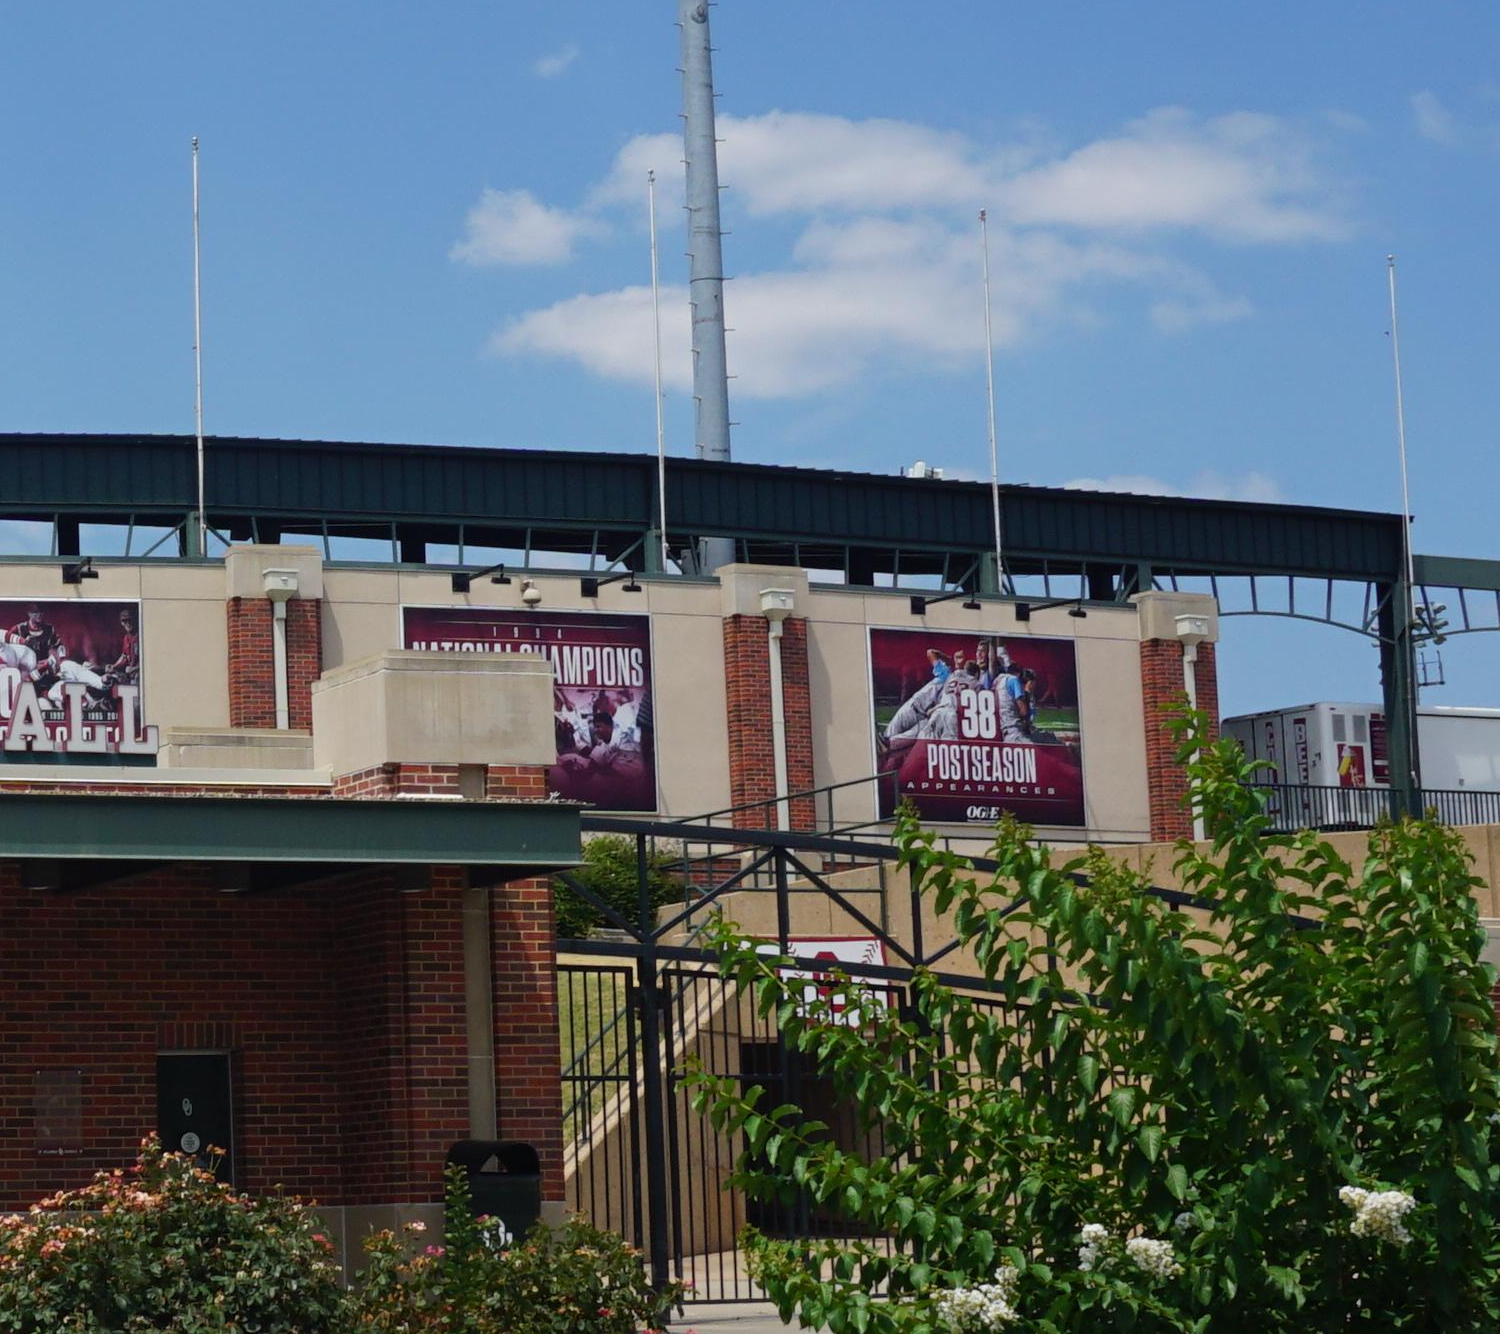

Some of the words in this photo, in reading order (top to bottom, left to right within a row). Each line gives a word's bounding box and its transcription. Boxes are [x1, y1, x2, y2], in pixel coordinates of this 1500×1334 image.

[961, 689, 996, 739] 38
[927, 744, 1037, 784] POSTSEASON
[907, 781, 1055, 795] APPEARANCES
